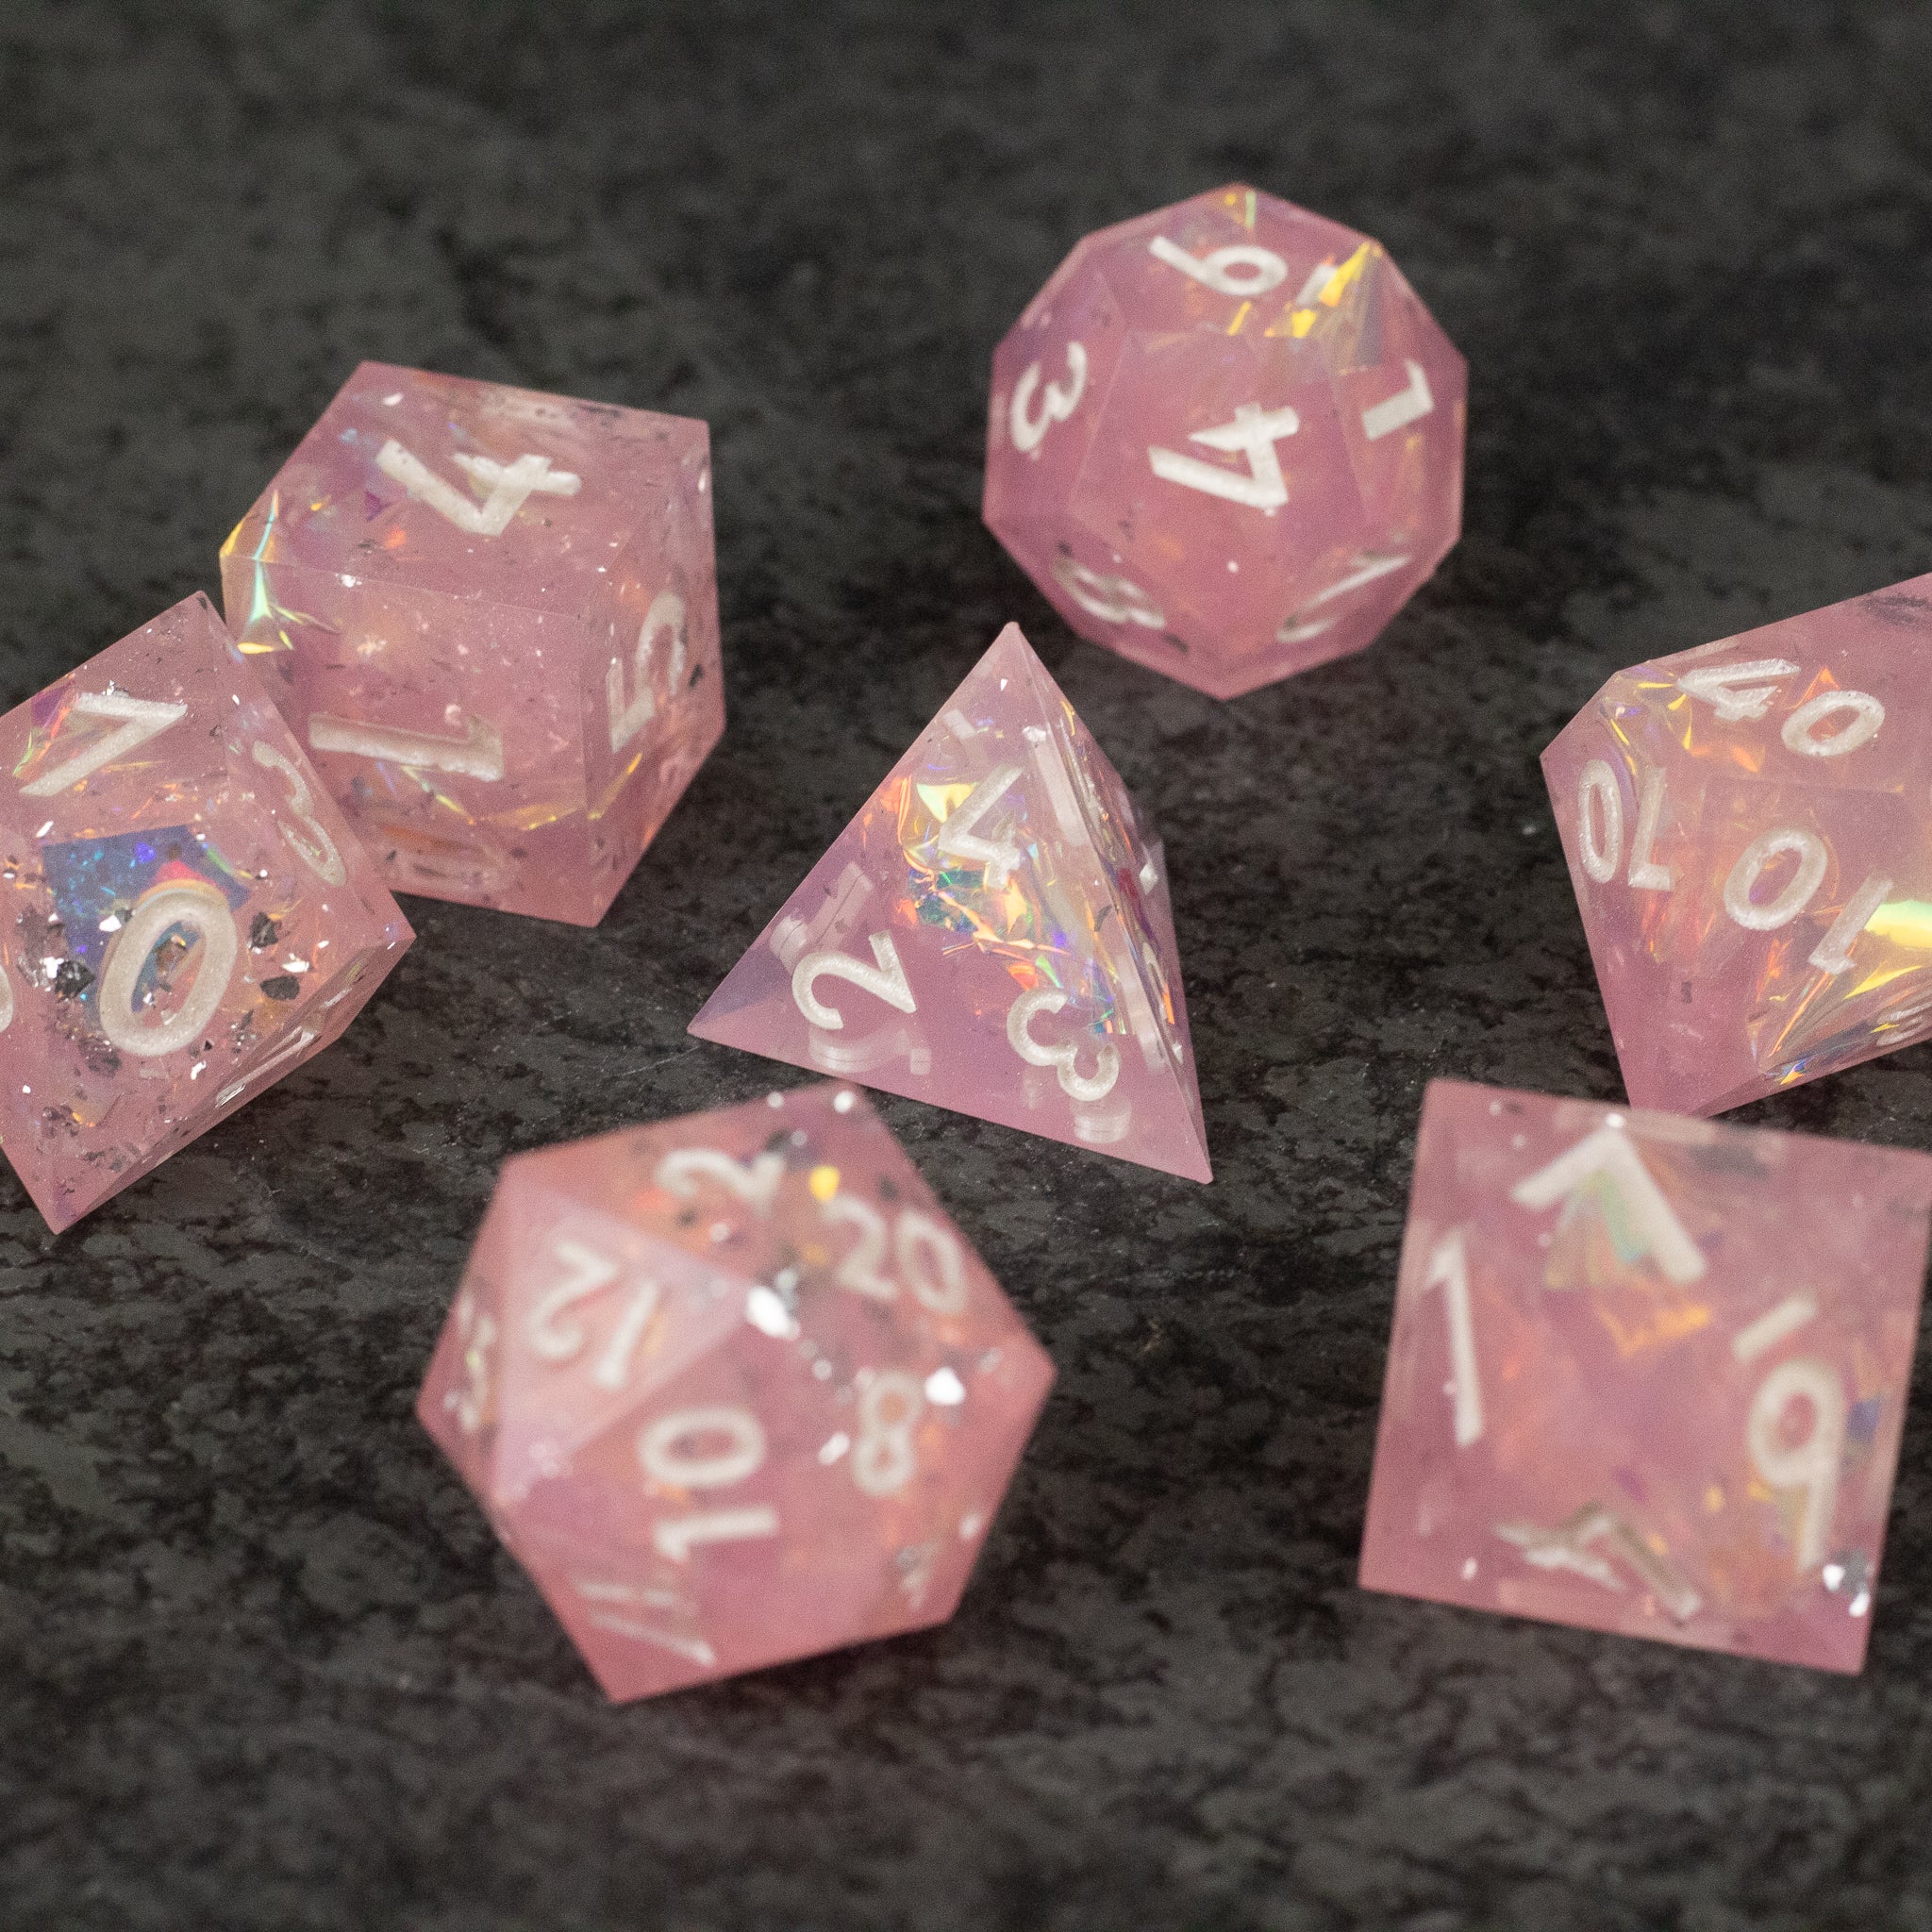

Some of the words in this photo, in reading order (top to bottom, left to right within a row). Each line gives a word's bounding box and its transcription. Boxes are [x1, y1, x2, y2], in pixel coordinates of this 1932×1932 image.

[1010, 341, 1087, 453] 3
[1148, 403, 1299, 508] 4
[377, 439, 582, 537] 4
[20, 691, 188, 797] 7
[1678, 658, 1886, 757] 40
[252, 741, 346, 886] 3
[1577, 758, 1674, 891] 70
[1724, 827, 1894, 975] 10
[99, 887, 238, 1057] 0
[791, 930, 917, 1029] 2
[1007, 990, 1120, 1102] 3
[525, 1241, 658, 1390] 12
[824, 1194, 968, 1316] 20
[1426, 1224, 1483, 1448] 1
[636, 1406, 778, 1561] 10
[852, 1369, 922, 1497] 8
